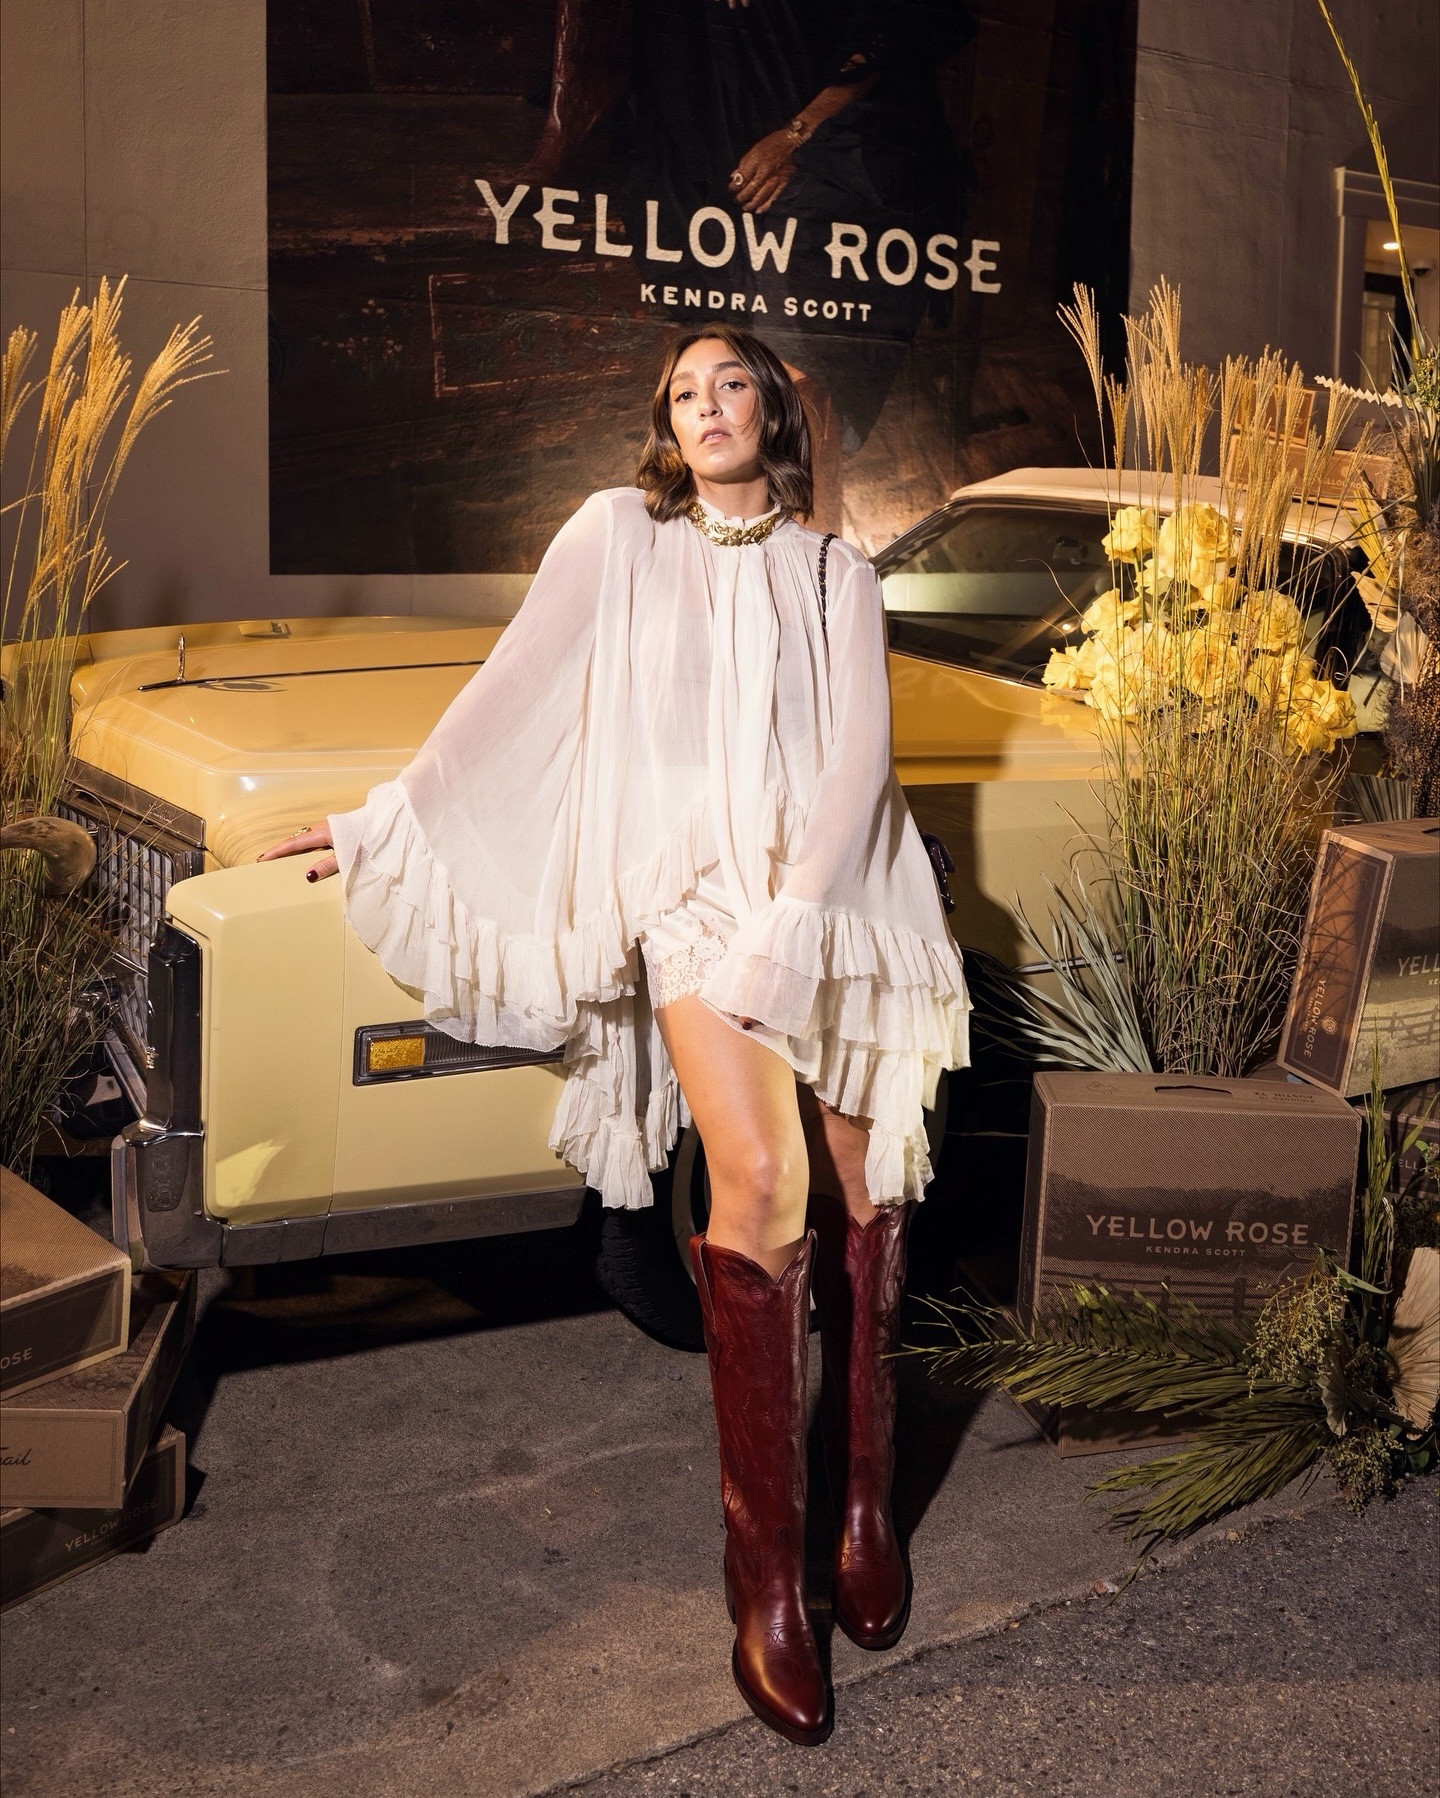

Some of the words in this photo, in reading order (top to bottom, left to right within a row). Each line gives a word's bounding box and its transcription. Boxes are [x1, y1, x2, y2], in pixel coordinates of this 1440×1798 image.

[474, 179, 797, 275] YELLOW
[824, 222, 1001, 294] ROSE
[640, 283, 768, 315] KENDRA
[784, 296, 871, 323] SCOTT
[1311, 979, 1327, 1025] YELLOW
[1303, 1026, 1317, 1058] ROSE
[1086, 1214, 1213, 1241] YELLOW
[1225, 1221, 1309, 1245] ROSE
[1145, 1245, 1199, 1255] KENDRA
[1205, 1248, 1246, 1257] SCOTT
[65, 1518, 120, 1552] YELLOW
[124, 1497, 159, 1521] ROSE
